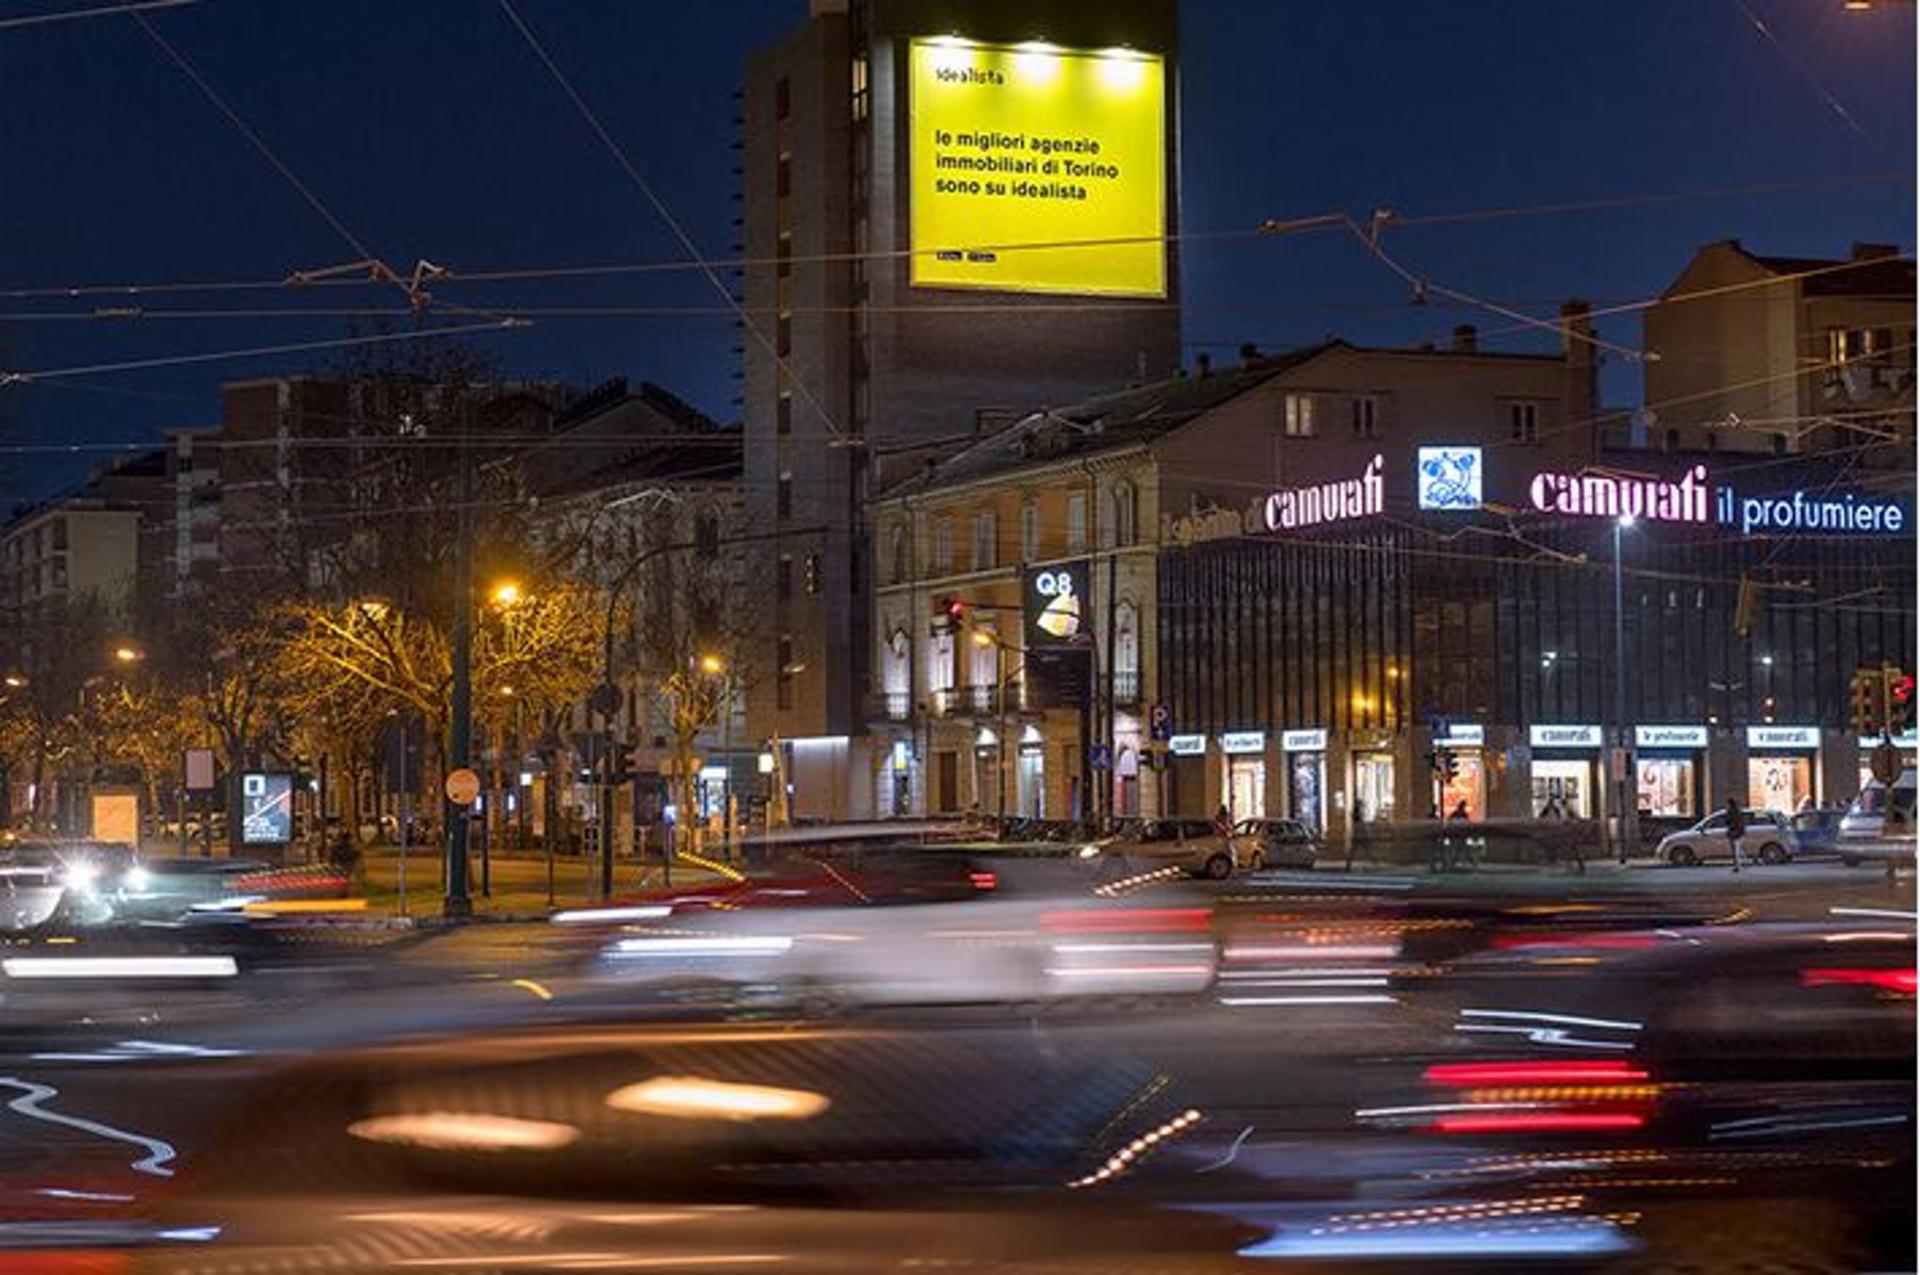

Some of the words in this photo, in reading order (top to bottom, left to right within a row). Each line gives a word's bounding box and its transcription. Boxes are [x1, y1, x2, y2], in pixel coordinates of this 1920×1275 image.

[936, 66, 1003, 85] idealista
[935, 129, 951, 147] le
[957, 131, 1024, 152] migliori
[1031, 137, 1100, 156] agenzie
[936, 152, 1038, 174] immobiliari
[1042, 159, 1059, 175] di
[1063, 160, 1119, 179] Torino
[936, 178, 981, 195] sono
[985, 181, 1006, 196] su
[1012, 180, 1087, 201] idealista
[1265, 453, 1384, 532] camurati
[1530, 464, 1708, 524] camurati
[1717, 486, 1735, 524] il
[1742, 491, 1903, 534] profumiere
[1036, 572, 1074, 597] Q8
